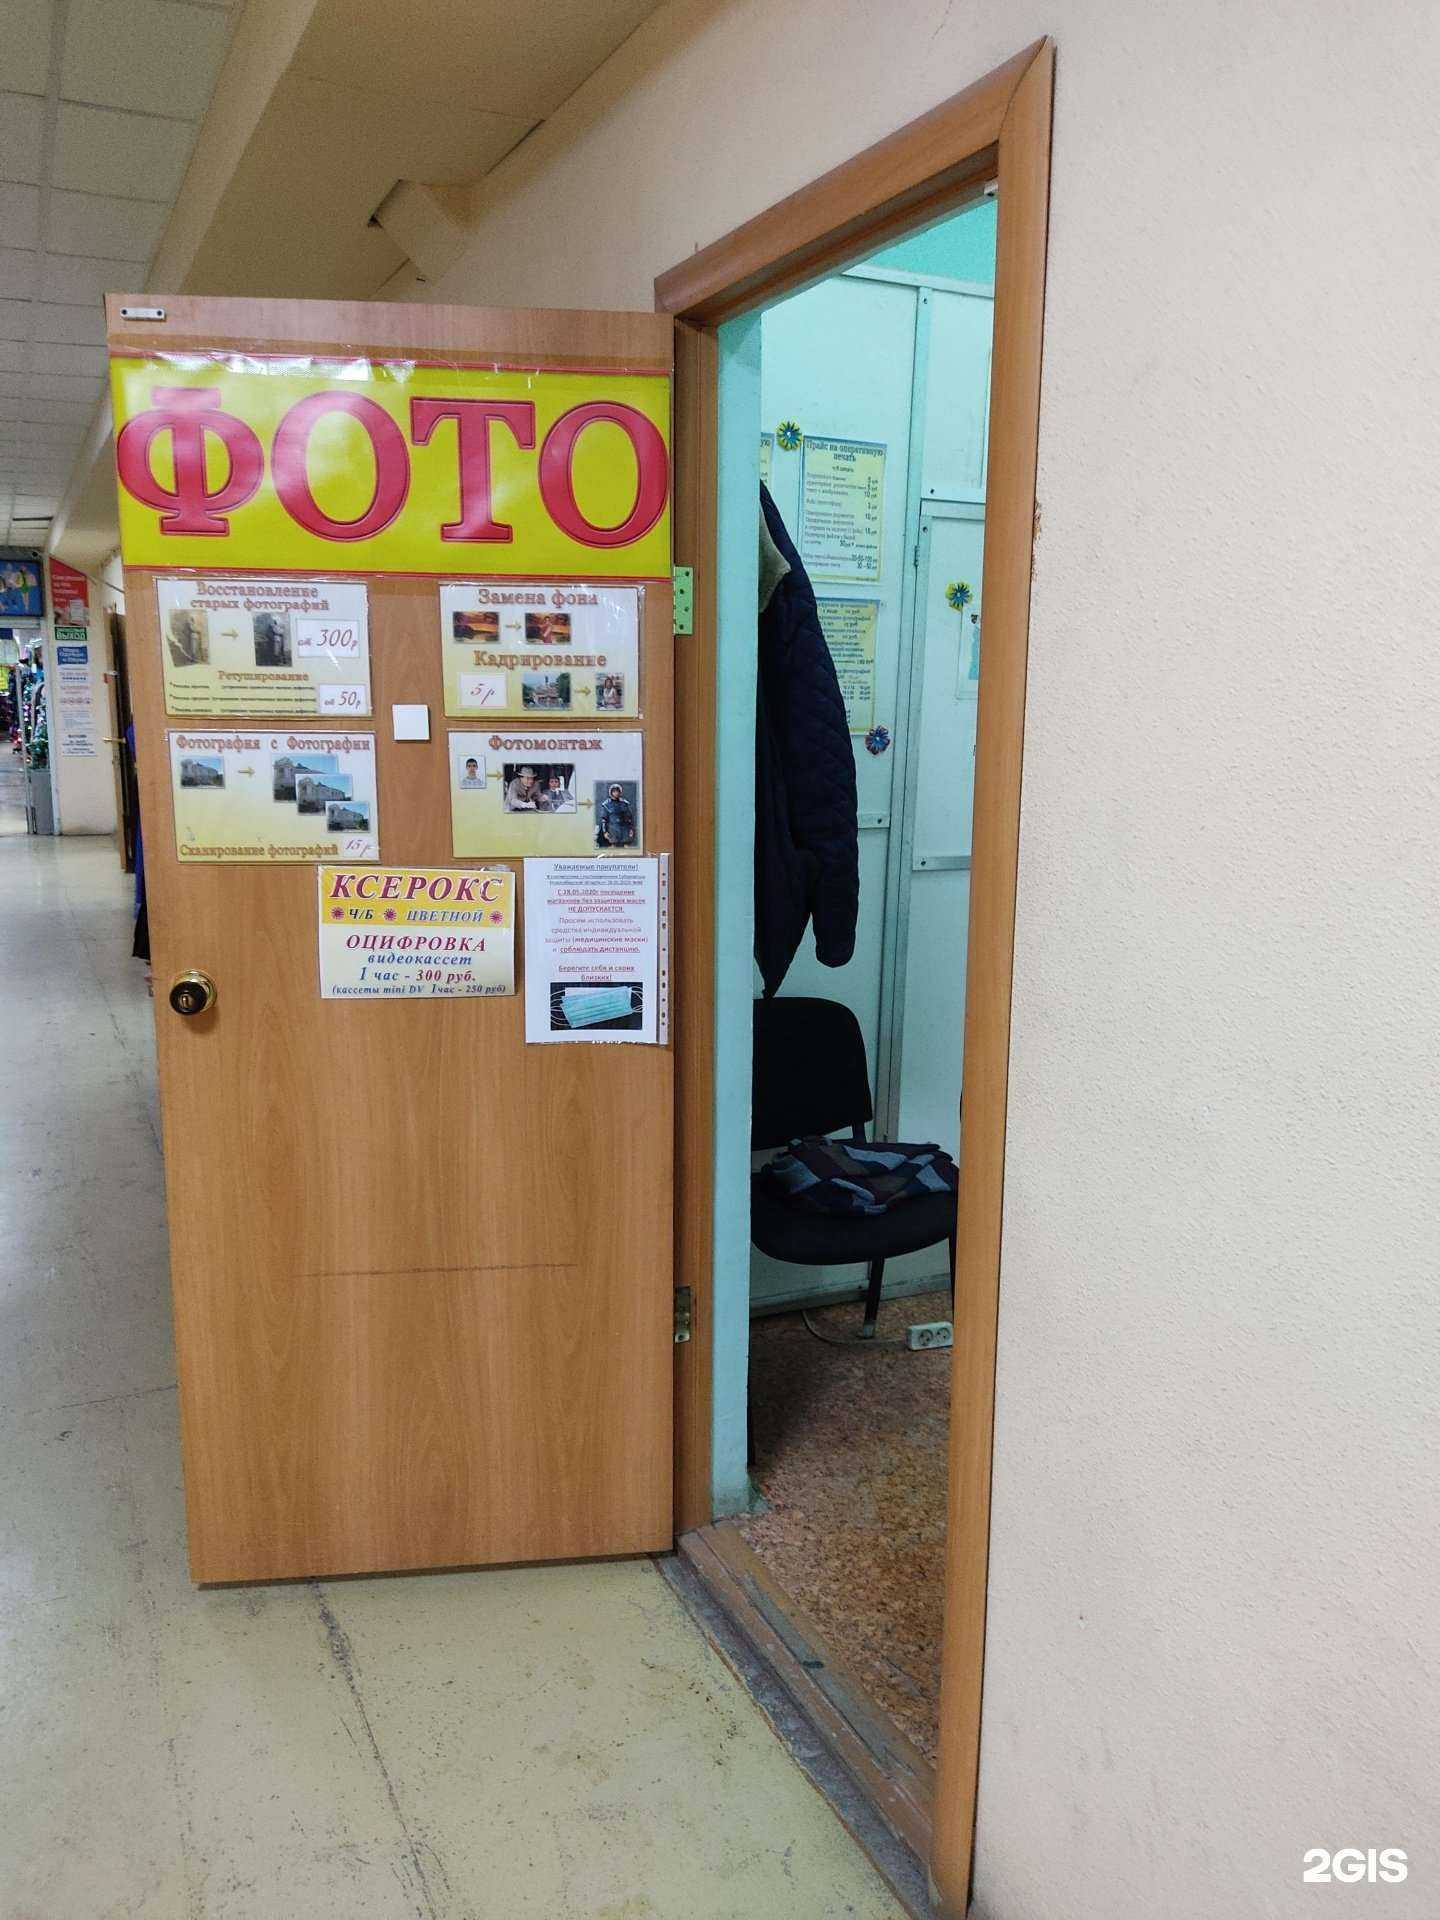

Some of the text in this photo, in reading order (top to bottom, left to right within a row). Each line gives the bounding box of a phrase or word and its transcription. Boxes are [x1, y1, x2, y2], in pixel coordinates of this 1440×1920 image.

[833, 453, 856, 462] печать
[839, 446, 884, 457] оперативную
[117, 385, 671, 549] ФОТО
[196, 581, 319, 598] Восстановление
[190, 598, 329, 613] старых фотографий
[478, 589, 599, 608] Замена фона
[57, 632, 86, 640] ВЫХОД
[473, 650, 608, 670] Кадрирование
[217, 670, 309, 683] Ретуширование
[176, 735, 370, 753] Фотография с Фотографии
[488, 735, 603, 751] Фотомонтаж
[180, 844, 339, 859] Сканирование фотографий
[553, 863, 639, 871] Уважаемые покупатели!
[329, 873, 503, 902] КСЕРОКС
[349, 908, 484, 923] Ч/Б ЦВЕТНОЙ
[559, 917, 586, 925] Просим
[551, 927, 582, 935] средства
[346, 934, 486, 952] ОЦИФРОВКА
[572, 936, 623, 944] (медицинские
[367, 952, 472, 965] видеокассет
[359, 966, 367, 981] 1
[374, 971, 399, 981] час
[415, 969, 442, 982] 300
[446, 969, 476, 984] руб.
[332, 985, 380, 995] (кассеты
[383, 985, 406, 994] mini
[409, 985, 425, 994] DV
[465, 985, 483, 993] 250
[484, 985, 507, 995] руб)
